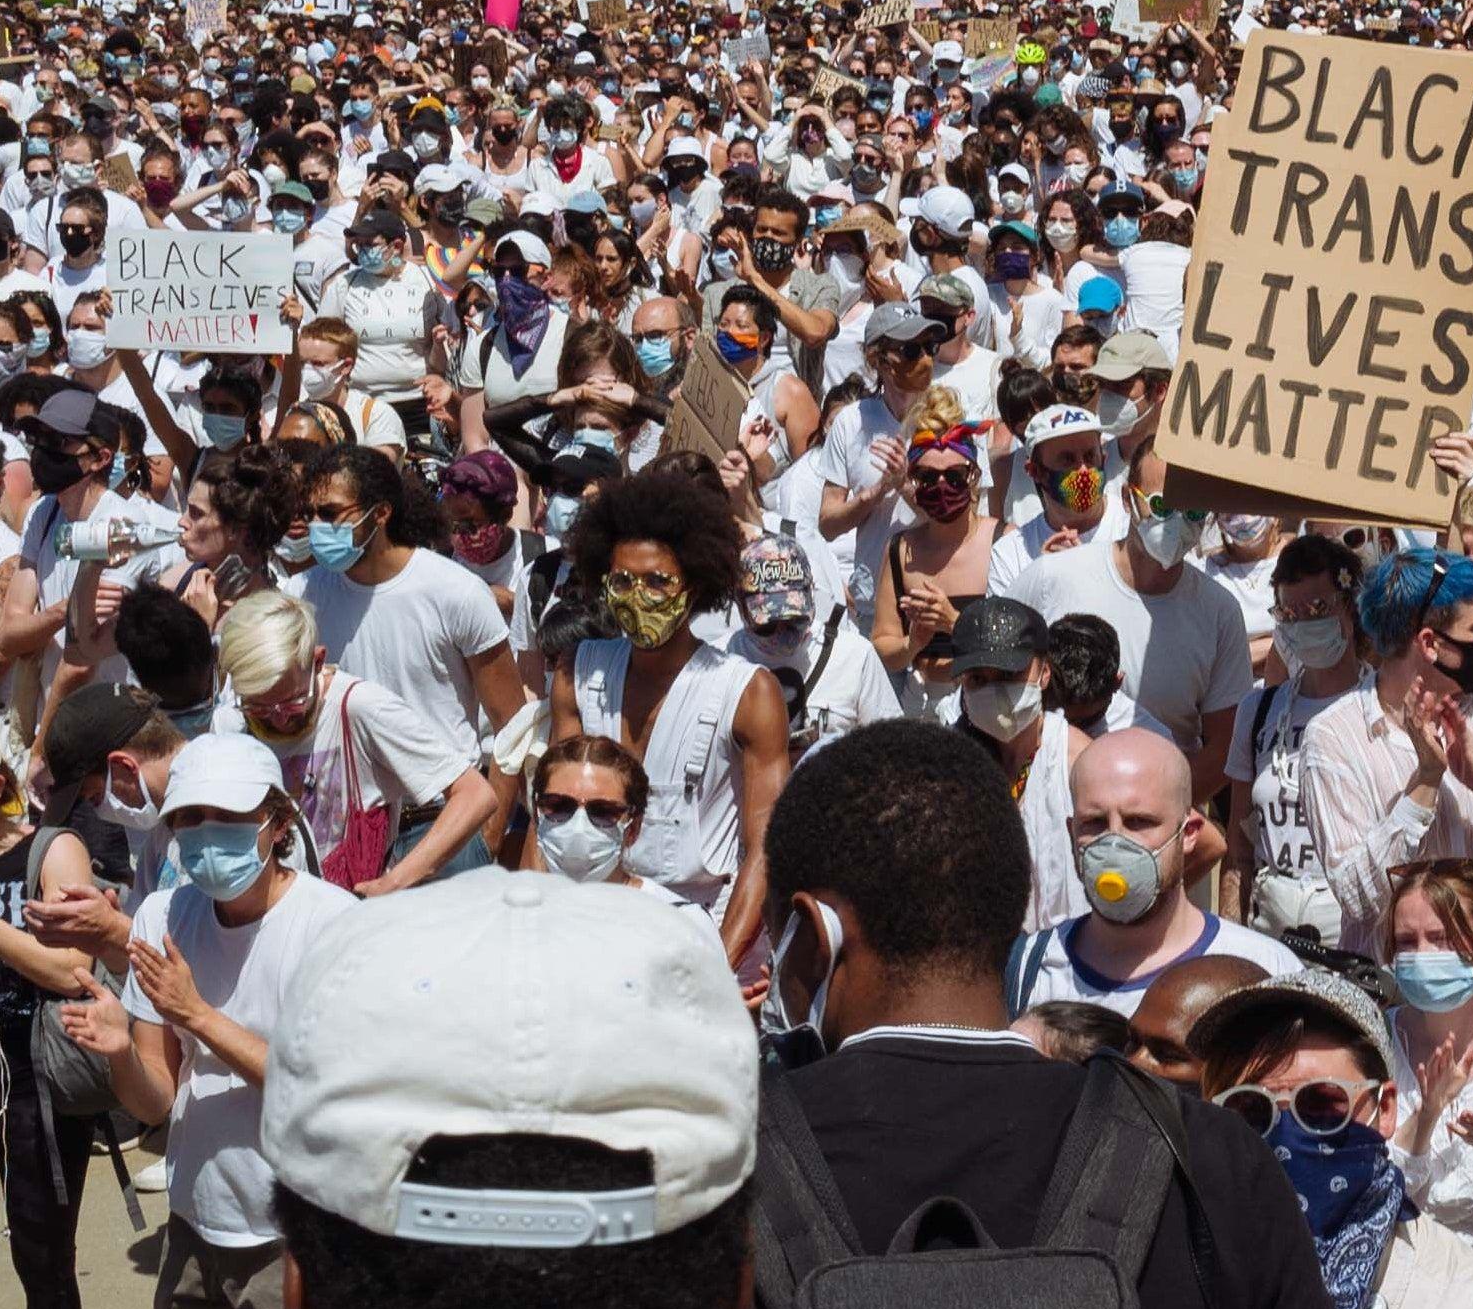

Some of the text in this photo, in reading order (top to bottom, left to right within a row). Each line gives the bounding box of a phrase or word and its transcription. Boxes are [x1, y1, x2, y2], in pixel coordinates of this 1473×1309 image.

[118, 236, 246, 282] BLACK
[112, 281, 287, 316] TRANS LIVES
[146, 311, 262, 346] MATTER!
[1169, 360, 1464, 496] MATTER
[752, 557, 805, 586] New York
